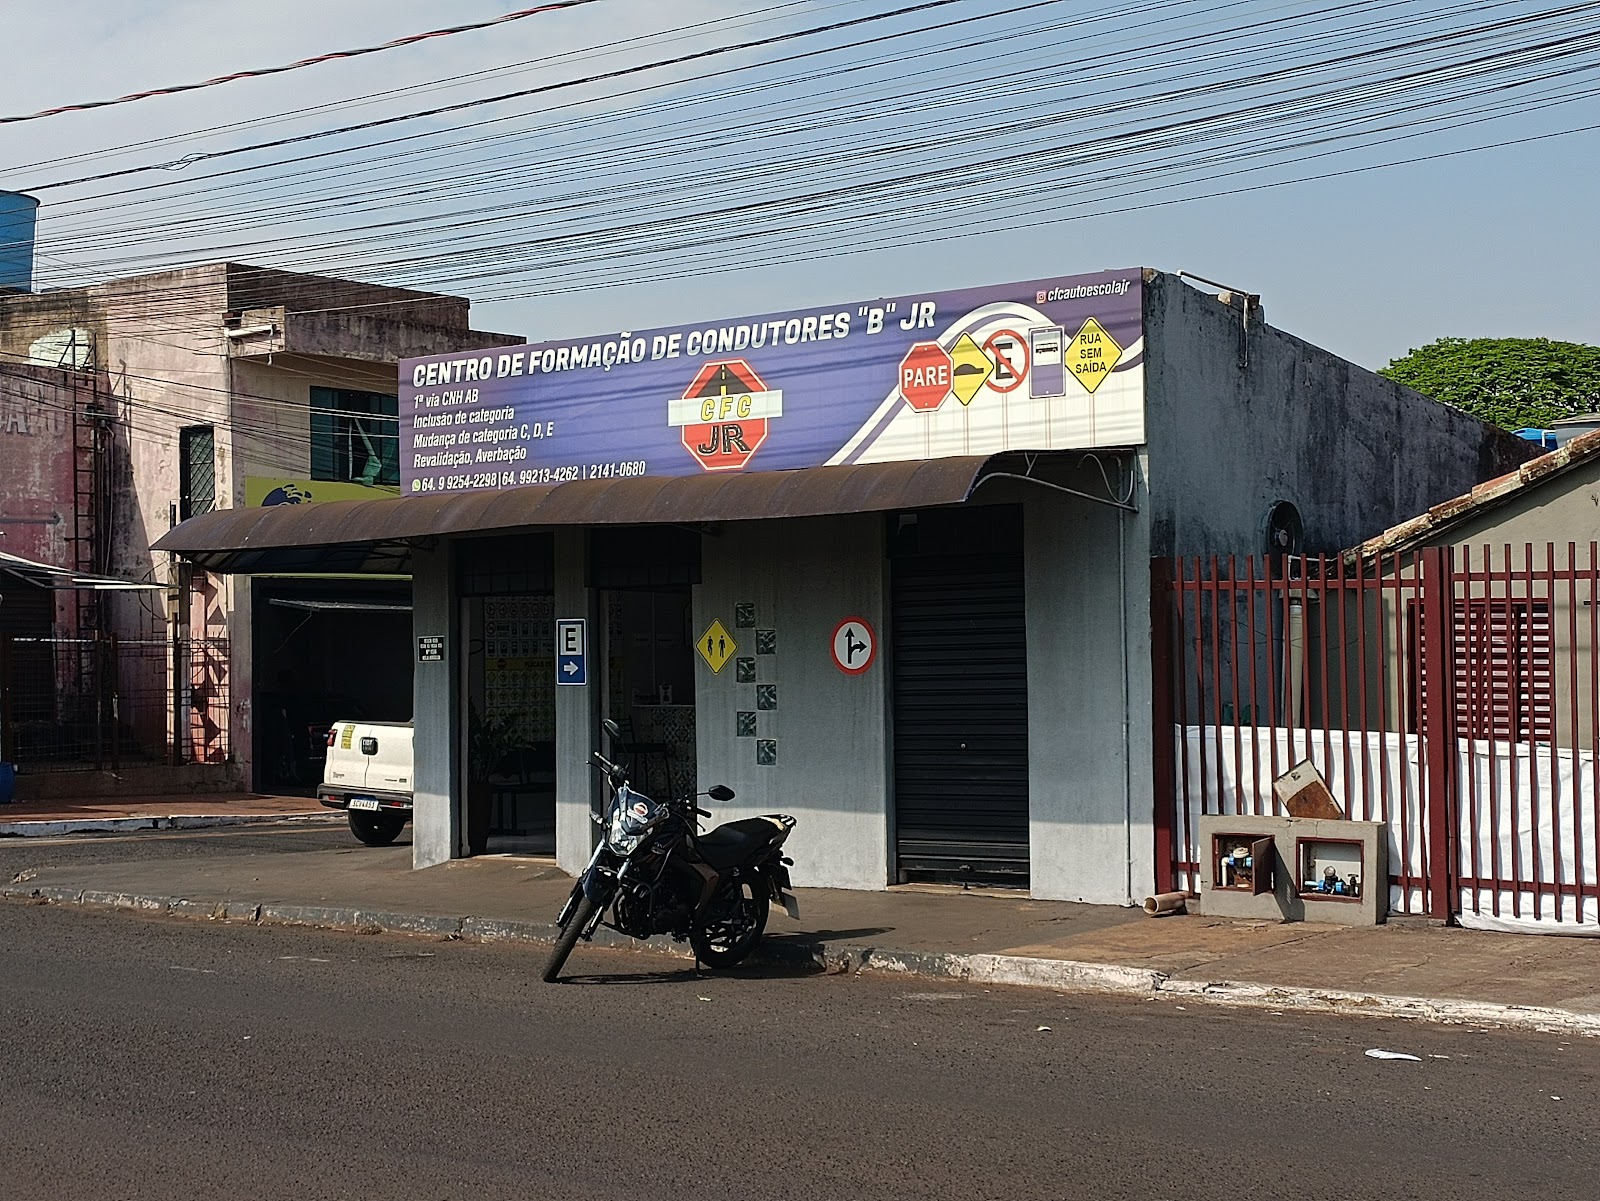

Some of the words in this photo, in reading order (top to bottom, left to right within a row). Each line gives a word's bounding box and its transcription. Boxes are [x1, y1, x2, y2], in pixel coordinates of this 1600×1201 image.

[1048, 279, 1130, 302] cfcautoescolajr
[413, 359, 492, 388] CENTRO
[496, 355, 525, 378] DE
[528, 332, 647, 375] FORMAÇÃO
[651, 333, 682, 361] DE
[686, 312, 850, 356] CONDUTORES
[858, 303, 897, 335] "B"
[900, 301, 936, 331] JR
[1080, 333, 1102, 346] RUA
[1080, 349, 1102, 359] SEM
[904, 364, 948, 389] PARE
[1075, 360, 1107, 375] SAÍDA
[426, 393, 440, 408] via
[442, 389, 463, 406] CNH
[465, 388, 479, 403] AB
[700, 395, 752, 421] CFC
[413, 412, 452, 429] Inclusão
[455, 410, 467, 425] de
[469, 405, 515, 424] categoria
[413, 432, 456, 449] Mudança
[458, 430, 470, 444] de
[472, 425, 518, 444] categoria
[520, 423, 531, 440] C,
[533, 422, 544, 439] D,
[546, 421, 554, 437] E
[697, 424, 750, 456] JR
[413, 450, 473, 469] Revalidação,
[475, 446, 527, 464] Averbação
[438, 477, 445, 490] 9
[519, 466, 579, 484] 99213-4262
[590, 461, 646, 479] 2141-0680
[565, 628, 577, 652] E
